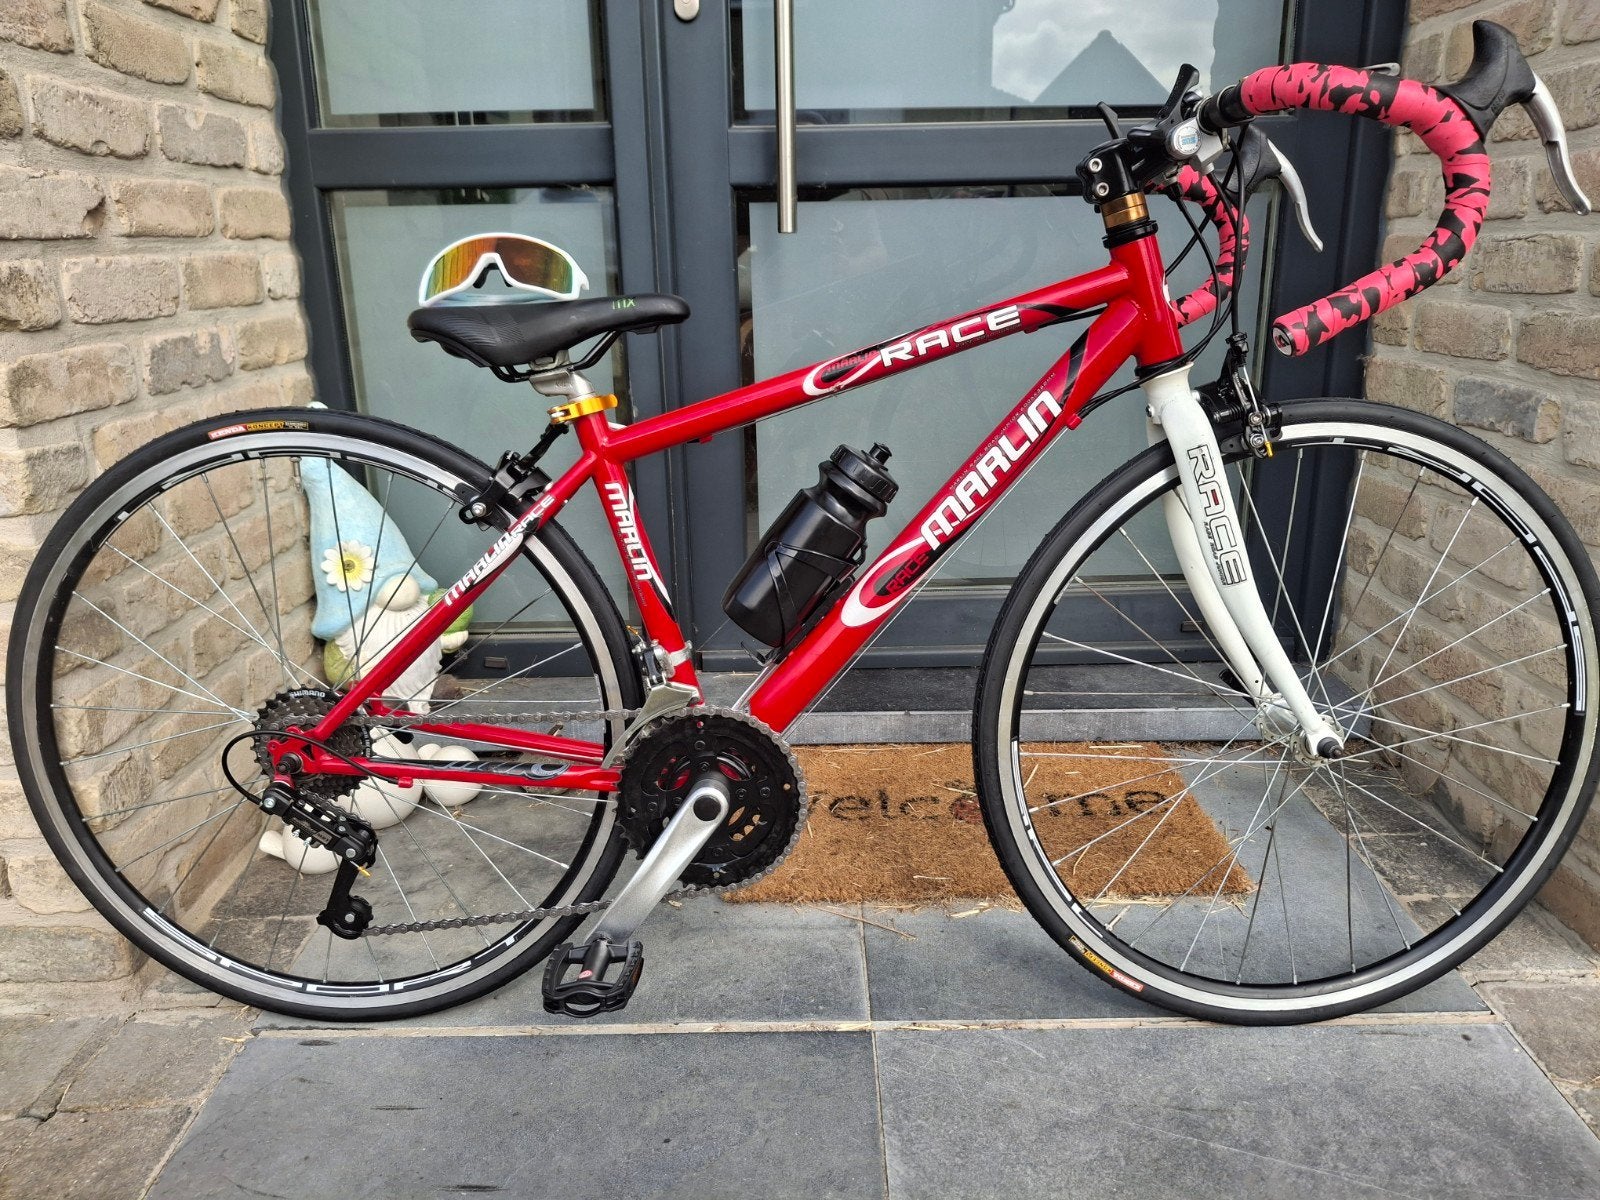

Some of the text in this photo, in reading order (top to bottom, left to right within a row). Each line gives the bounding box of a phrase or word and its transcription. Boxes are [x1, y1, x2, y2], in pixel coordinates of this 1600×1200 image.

[880, 305, 1022, 367] RACE
[211, 425, 246, 438] KENDA
[920, 390, 1062, 550] MARLIN
[444, 494, 555, 606] MARLIN RACE
[604, 482, 653, 581] MARLIN
[1187, 444, 1247, 586] RACE
[885, 553, 929, 594] RACE
[290, 690, 326, 698] SHIMANO
